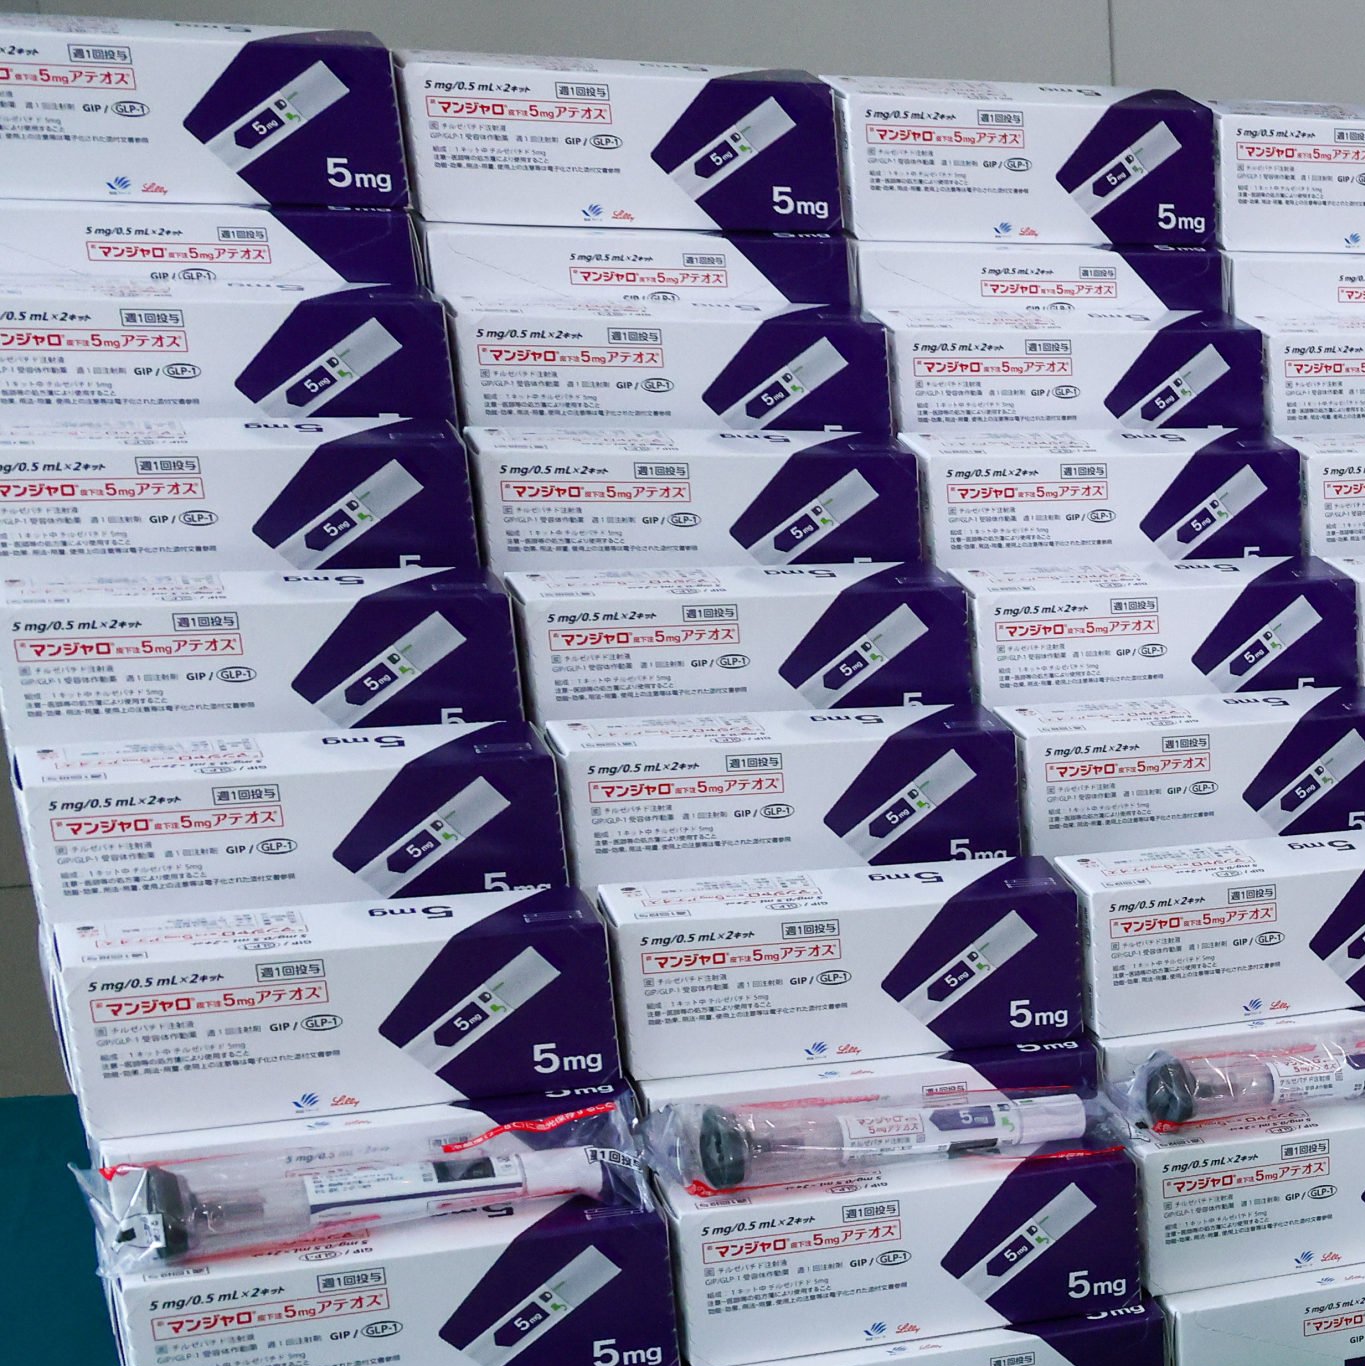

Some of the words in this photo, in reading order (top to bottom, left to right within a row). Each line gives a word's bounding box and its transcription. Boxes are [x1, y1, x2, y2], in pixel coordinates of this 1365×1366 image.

[73, 48, 128, 61] 週1回投与
[559, 86, 606, 97] 週1回投与
[980, 113, 1021, 124] 週1回投与
[327, 158, 391, 192] 5mg
[773, 187, 828, 219] 5mg
[1158, 204, 1205, 233] 5mg
[125, 313, 180, 324] 週1回投与
[1028, 343, 1069, 352] 週1回投与
[140, 460, 196, 471] 週1回投与
[638, 466, 686, 476] 週1回投与
[686, 608, 734, 619] 週1回投与
[177, 616, 235, 628] 週1回投与
[186, 672, 206, 681] GIP
[729, 757, 779, 768] 週1回投与
[217, 788, 276, 801] 週1回投与
[226, 845, 246, 854] GIP
[1231, 888, 1273, 900] 週1回投与
[786, 923, 836, 936] 週1回投与
[261, 964, 321, 978] 週1回投与
[789, 976, 807, 985] GIP
[1010, 1000, 1068, 1028] 5mg
[269, 1022, 290, 1032] GIP
[533, 1043, 602, 1074] 5mg
[1284, 1143, 1326, 1156] 週1回投与
[1285, 1193, 1300, 1201] GIP
[846, 1205, 896, 1219] 週1回投与
[849, 1258, 867, 1267] GIP
[322, 1272, 382, 1288] 週1回投与
[1068, 1271, 1126, 1298] 5mg
[330, 1331, 350, 1340] GIP
